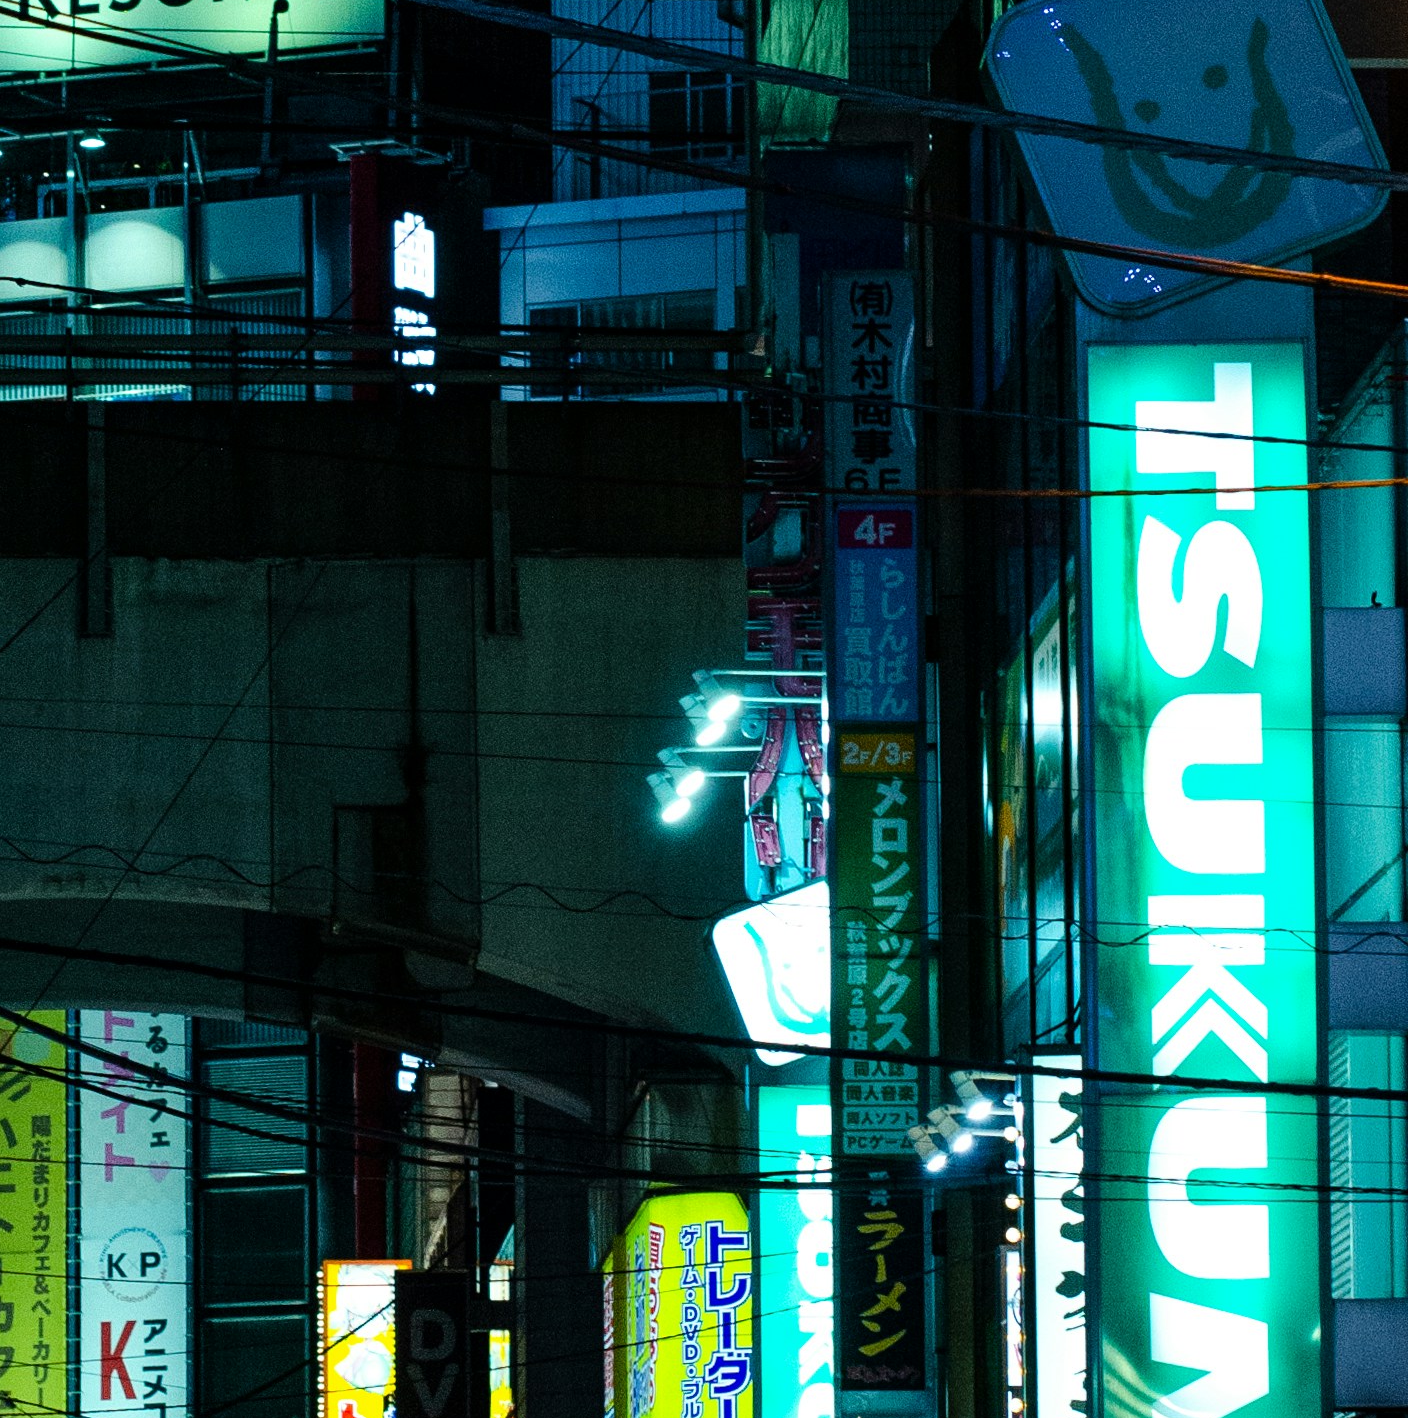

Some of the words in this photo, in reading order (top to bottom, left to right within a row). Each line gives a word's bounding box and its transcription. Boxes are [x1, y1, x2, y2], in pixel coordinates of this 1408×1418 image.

[852, 514, 896, 546] 4F
[877, 556, 909, 717] らしんばん
[871, 777, 911, 1057] メロンブックス
[856, 1209, 907, 1358] ラーメン
